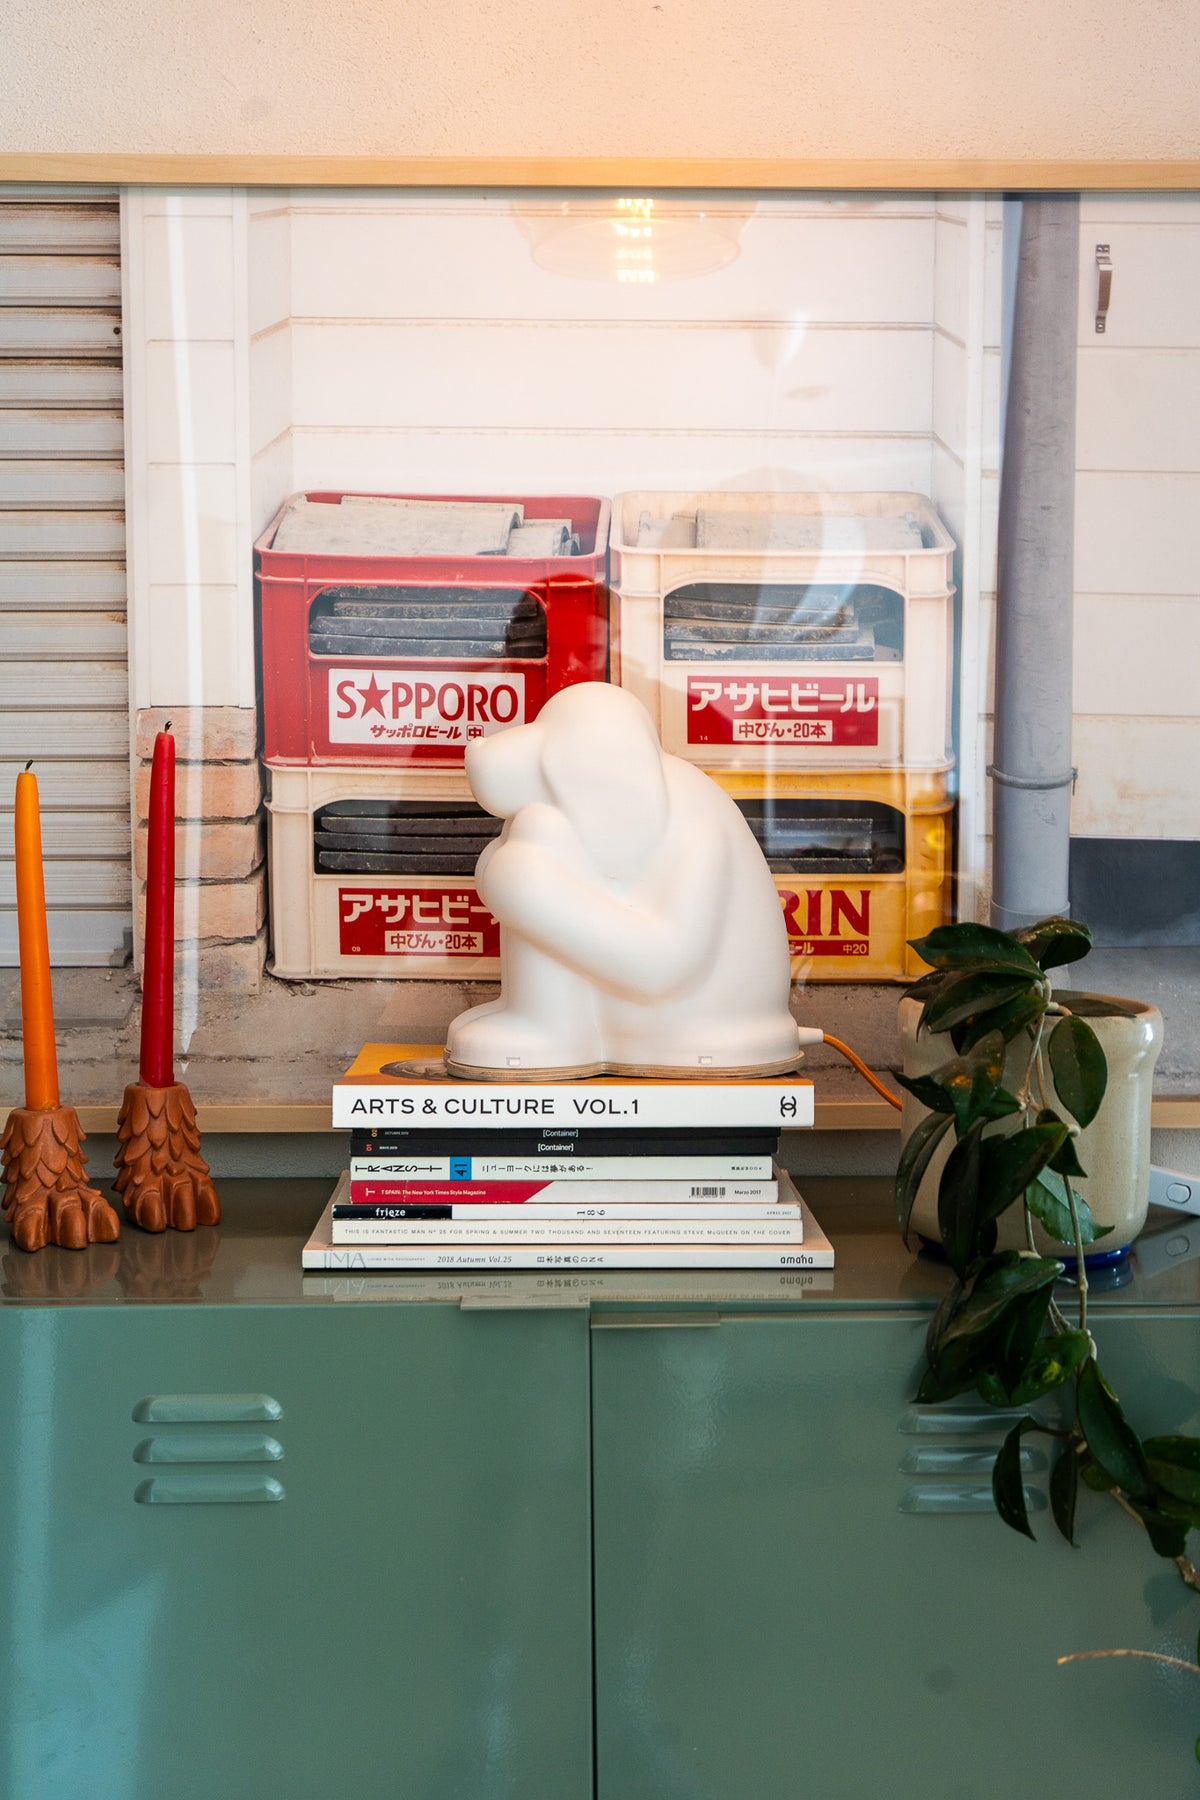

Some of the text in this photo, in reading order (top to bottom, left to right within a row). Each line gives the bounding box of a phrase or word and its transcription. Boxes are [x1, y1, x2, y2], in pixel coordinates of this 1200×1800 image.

[690, 682, 875, 713] アサヒビール
[370, 723, 462, 740] サッポロビール
[738, 721, 827, 739] 中びん・20本
[342, 894, 500, 925] アサヒビー
[778, 890, 871, 936] RIN
[390, 933, 477, 951] 中びん・20本
[842, 943, 867, 954] 中20
[351, 1098, 639, 1115] ARTS & CULTURE VOL.1
[542, 1129, 579, 1138] [Container]
[537, 1143, 574, 1152] [Container]
[355, 1165, 442, 1173] TRANSIT
[454, 1163, 468, 1177] 41
[365, 1187, 376, 1197] T
[449, 1189, 462, 1197] Style
[462, 1189, 487, 1197] Magazine
[375, 1208, 406, 1217] frieze
[323, 1252, 366, 1268] IMA
[436, 1255, 512, 1264] 2018 Autumn Vol.25
